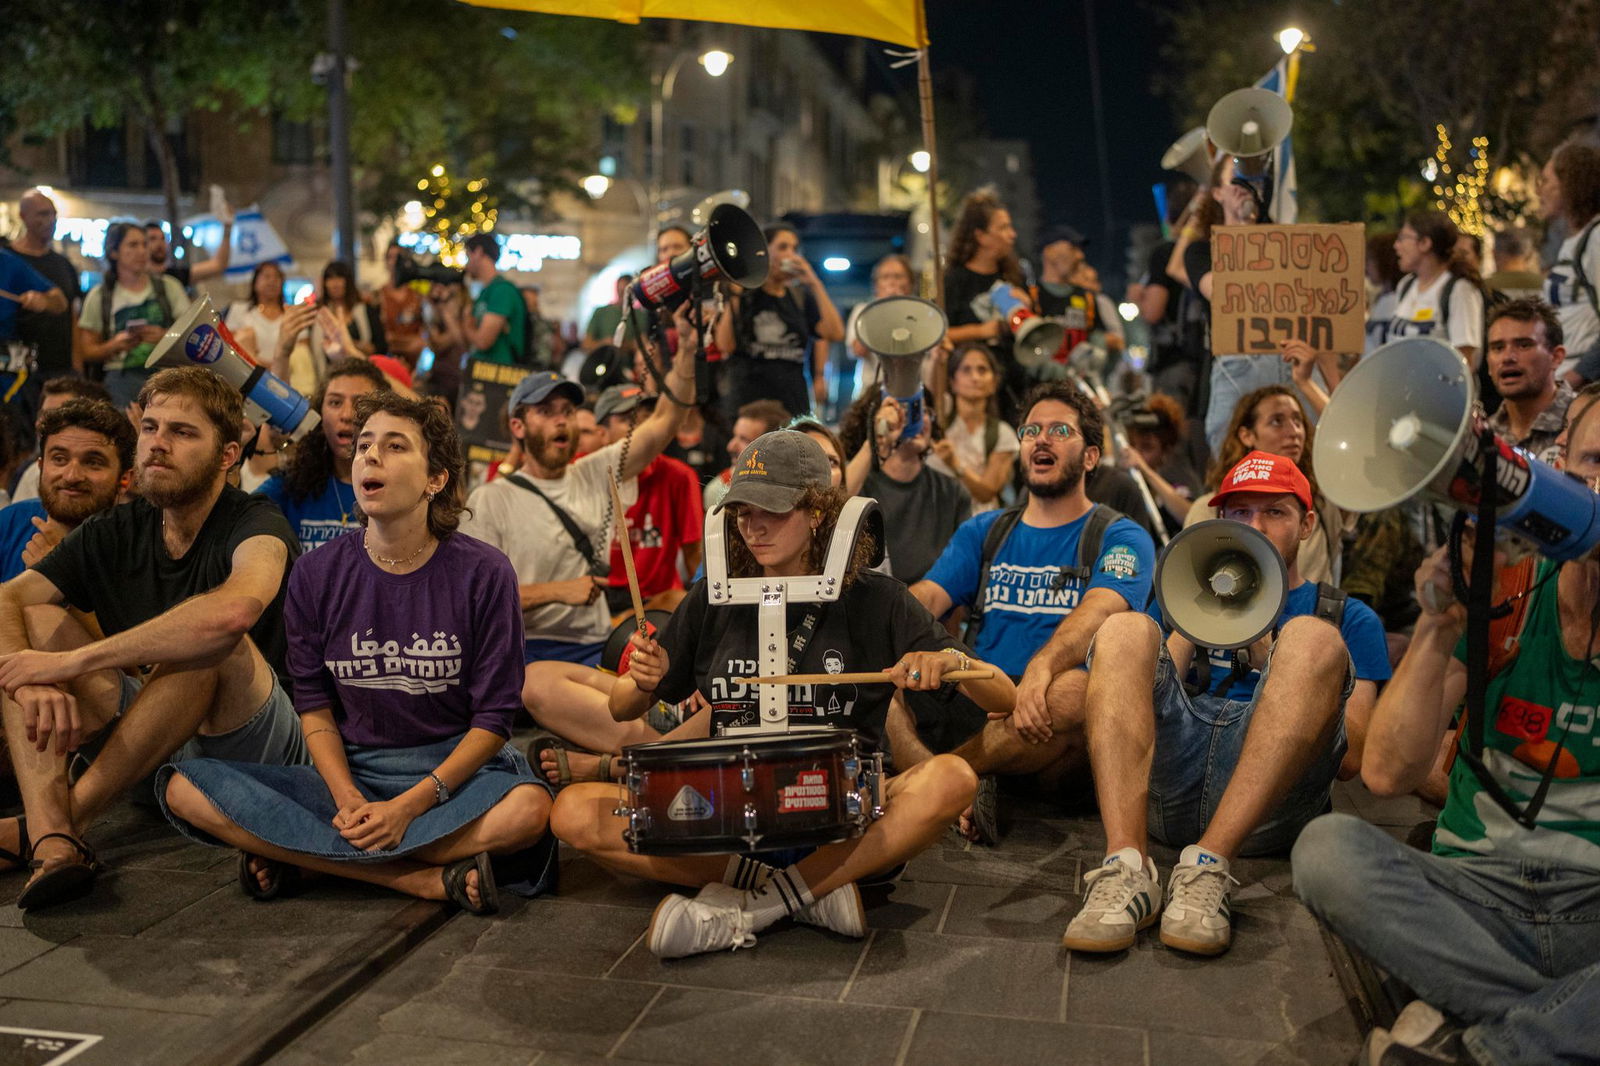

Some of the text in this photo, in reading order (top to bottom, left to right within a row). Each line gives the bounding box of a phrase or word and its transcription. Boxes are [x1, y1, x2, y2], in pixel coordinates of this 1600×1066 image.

[1215, 231, 1349, 273] מסרבות
[1221, 278, 1359, 315] למלחמת
[1237, 316, 1334, 352] חורבן
[1252, 458, 1275, 466] THIS
[1232, 470, 1271, 485] WAR
[1016, 587, 1079, 607] ואנחנו
[403, 631, 462, 657] نقف
[324, 656, 462, 678] עומדים ביחד
